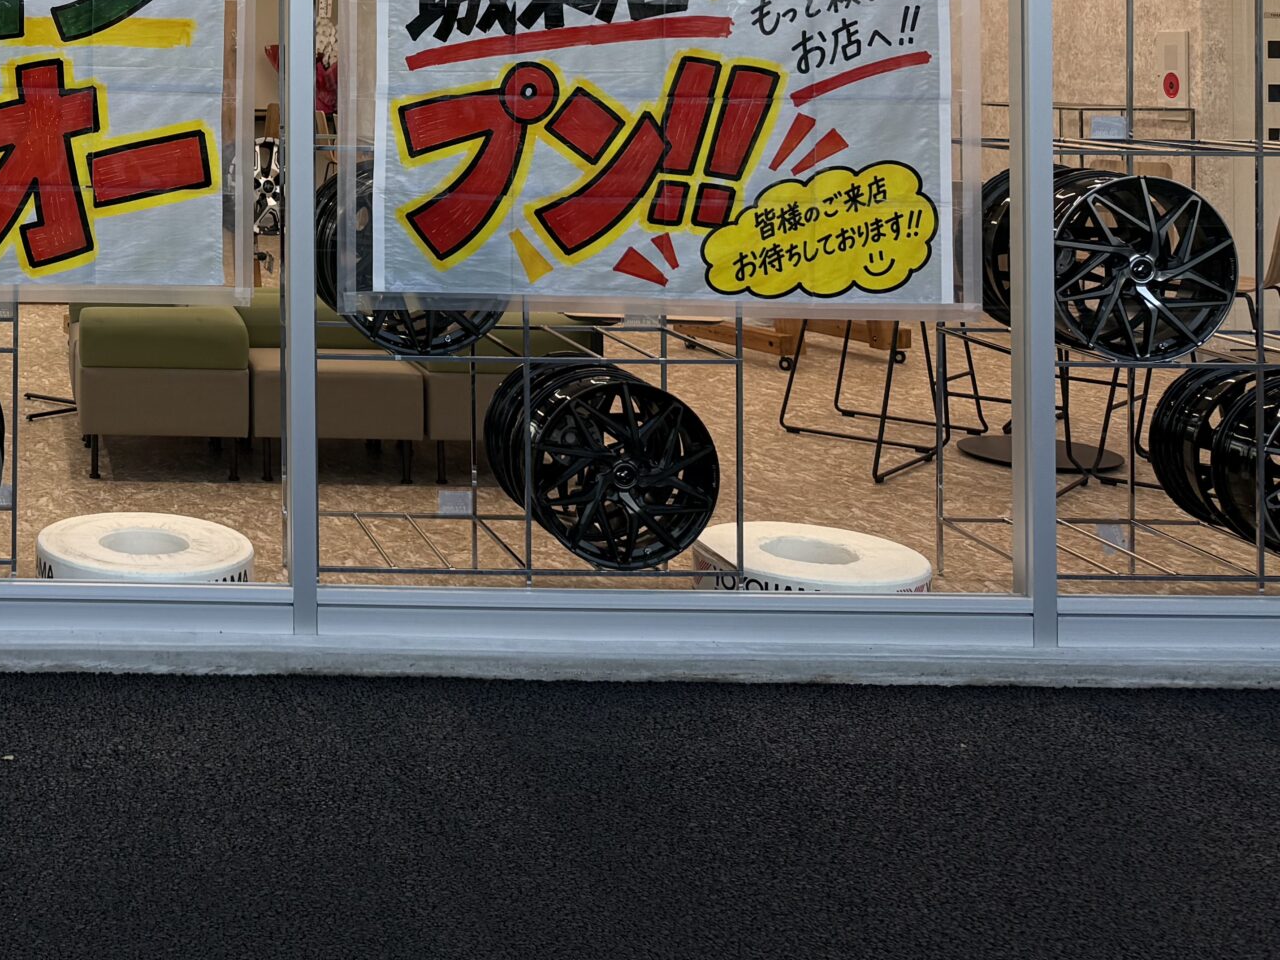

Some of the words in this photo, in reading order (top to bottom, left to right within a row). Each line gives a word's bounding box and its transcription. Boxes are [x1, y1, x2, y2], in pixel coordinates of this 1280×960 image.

[754, 175, 887, 240] 皆様のご来店
